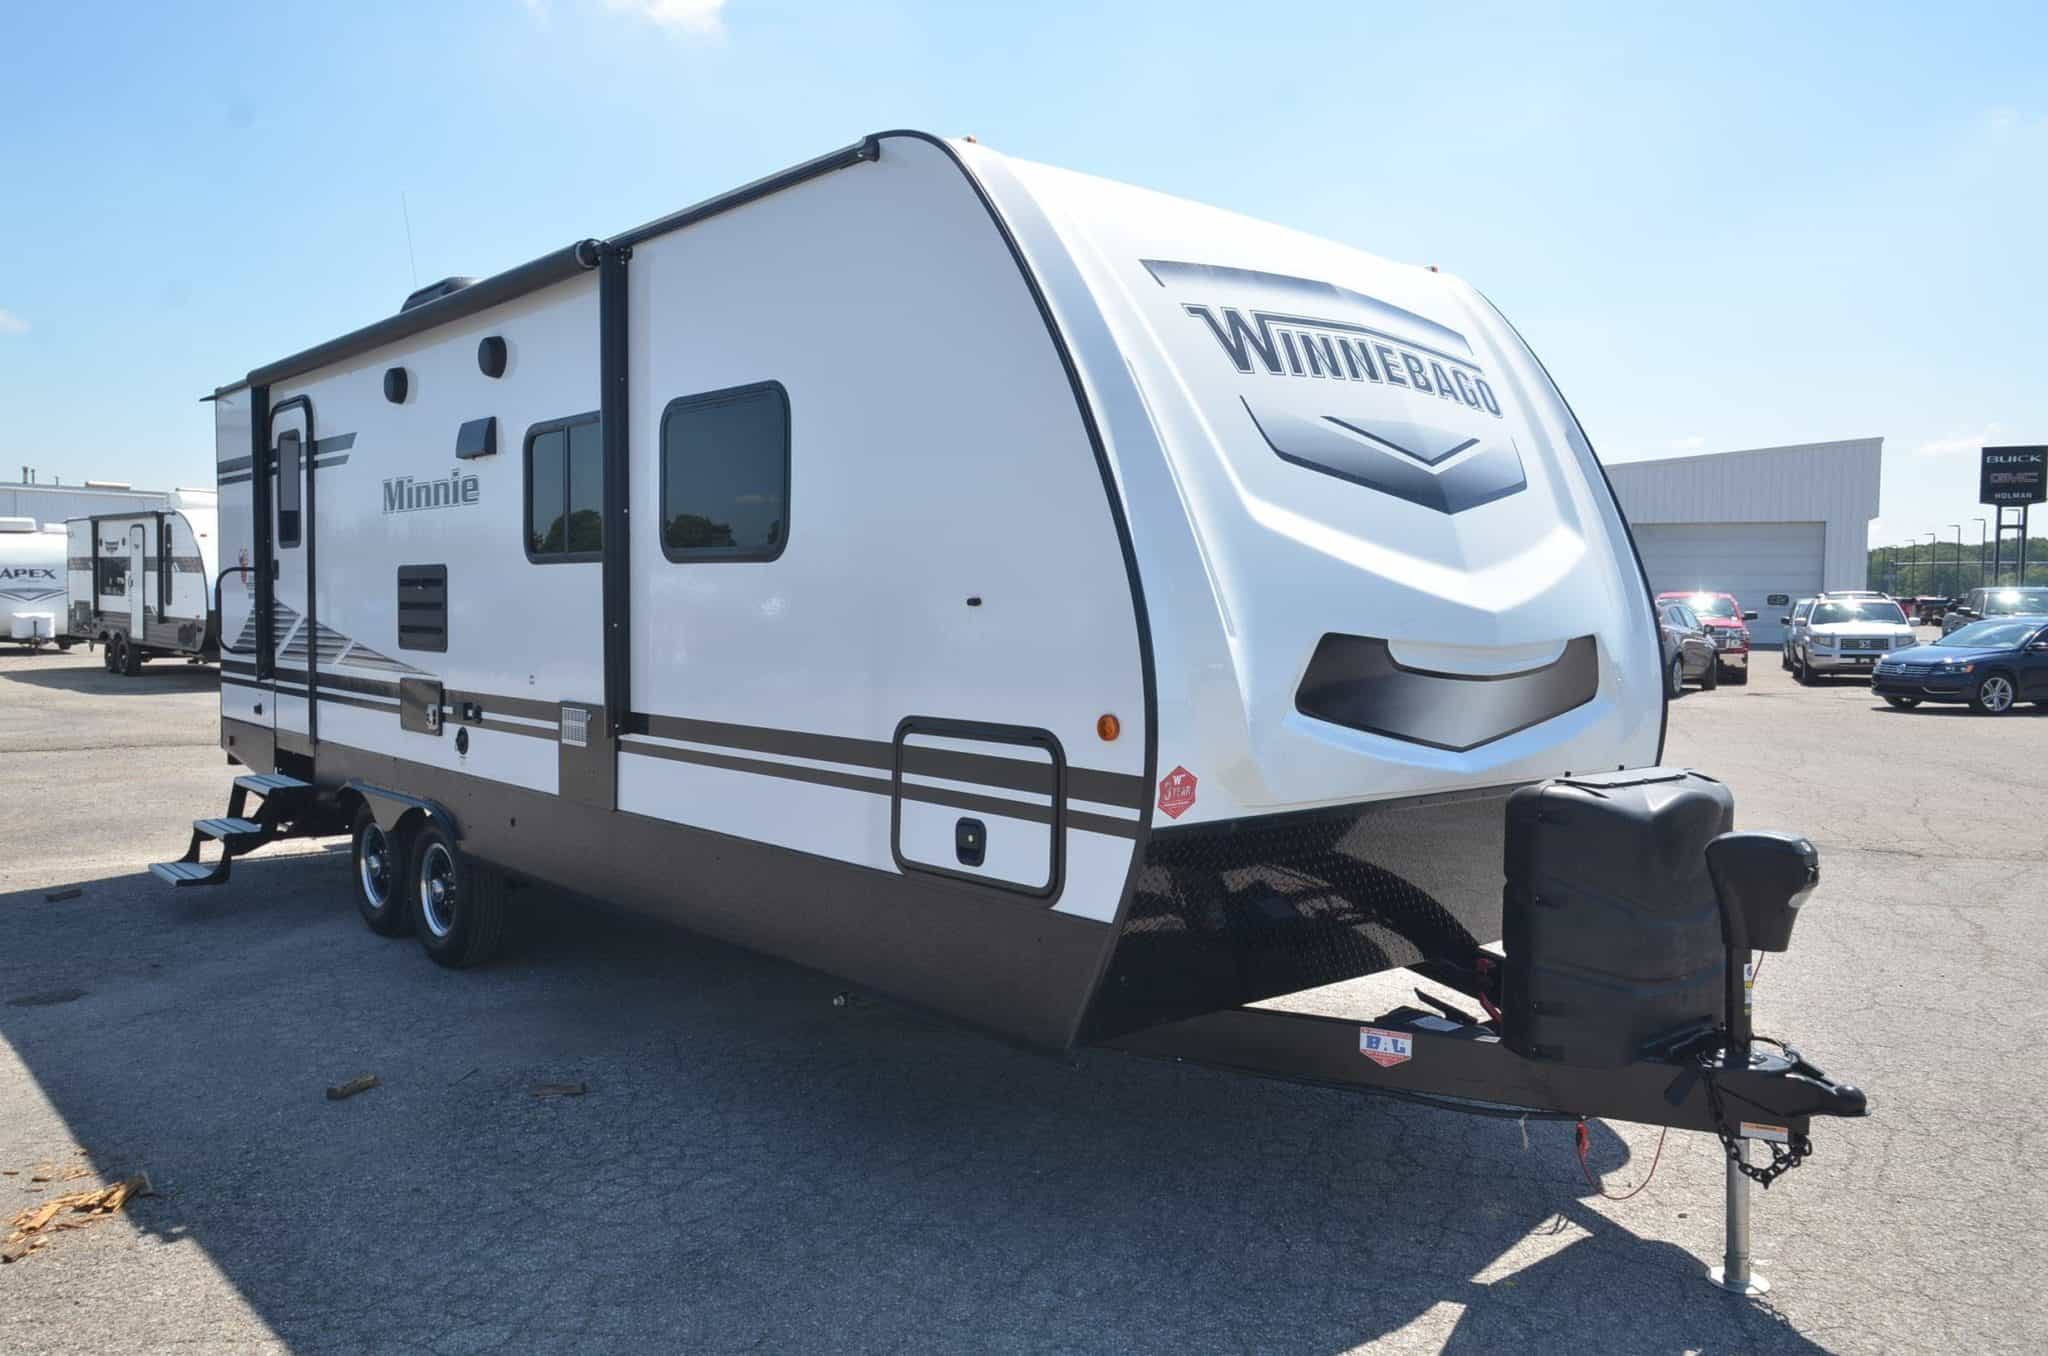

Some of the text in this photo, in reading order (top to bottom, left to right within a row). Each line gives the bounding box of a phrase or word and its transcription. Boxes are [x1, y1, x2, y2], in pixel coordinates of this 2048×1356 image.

[1181, 302, 1503, 418] WINNEBAGO
[1986, 455, 2041, 463] BUICK
[382, 467, 480, 513] Minnie
[0, 567, 57, 580] APEX
